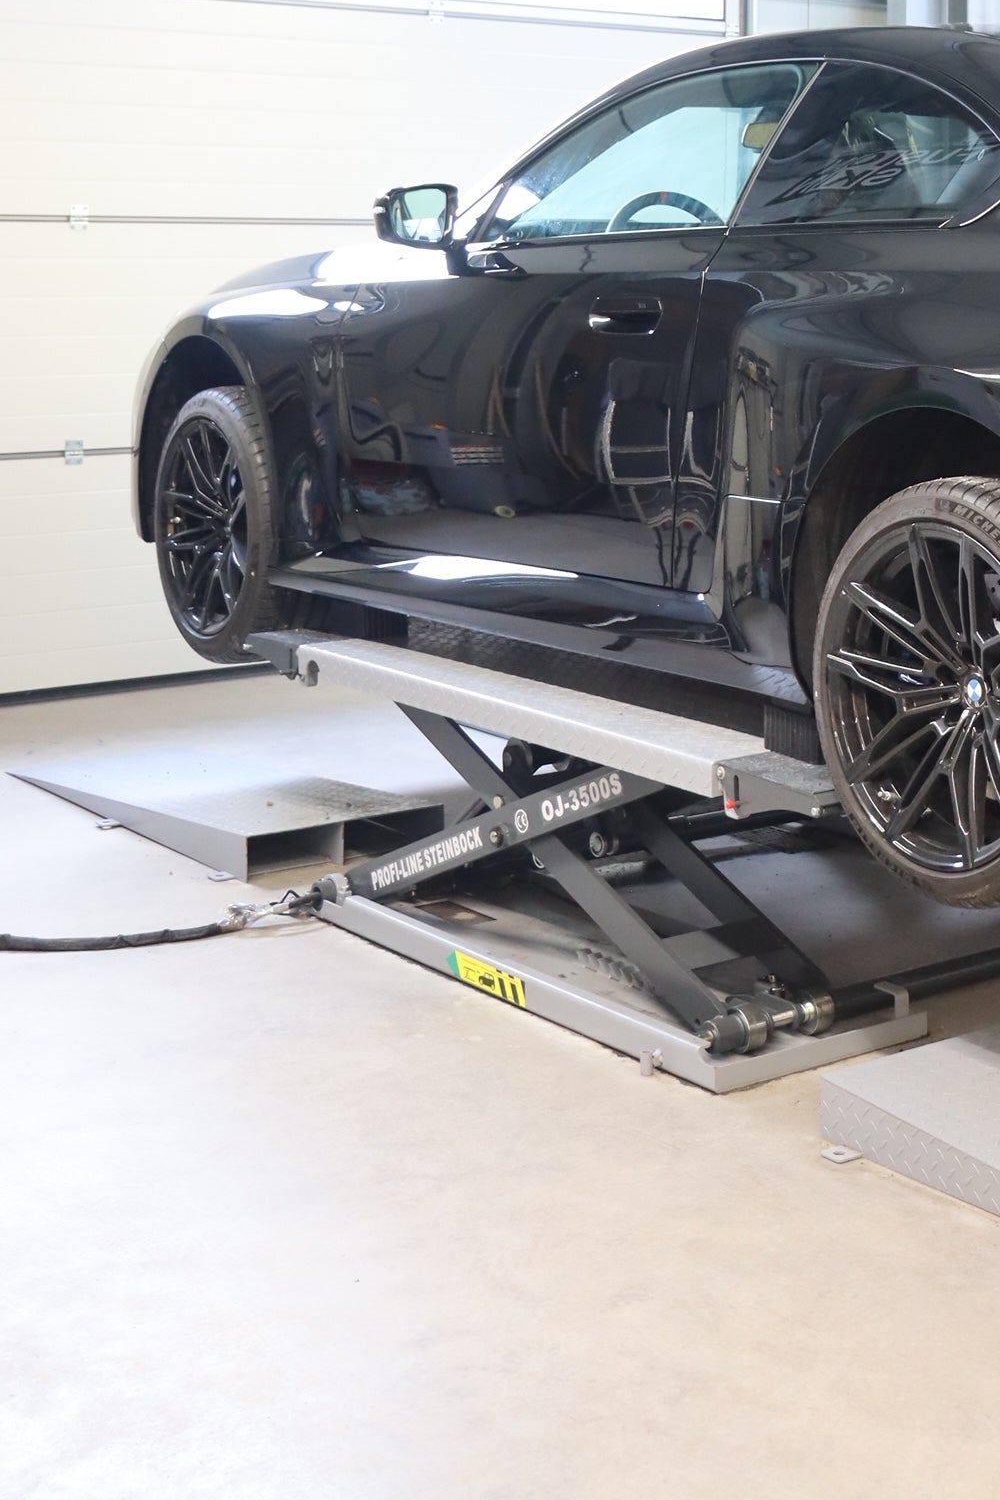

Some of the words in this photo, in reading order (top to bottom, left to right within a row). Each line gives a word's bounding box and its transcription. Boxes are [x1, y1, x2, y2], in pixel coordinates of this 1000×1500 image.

[541, 772, 623, 821] OJ-3500S
[371, 850, 424, 891] PROFI-LINE
[424, 826, 483, 868] STEINBOCK
